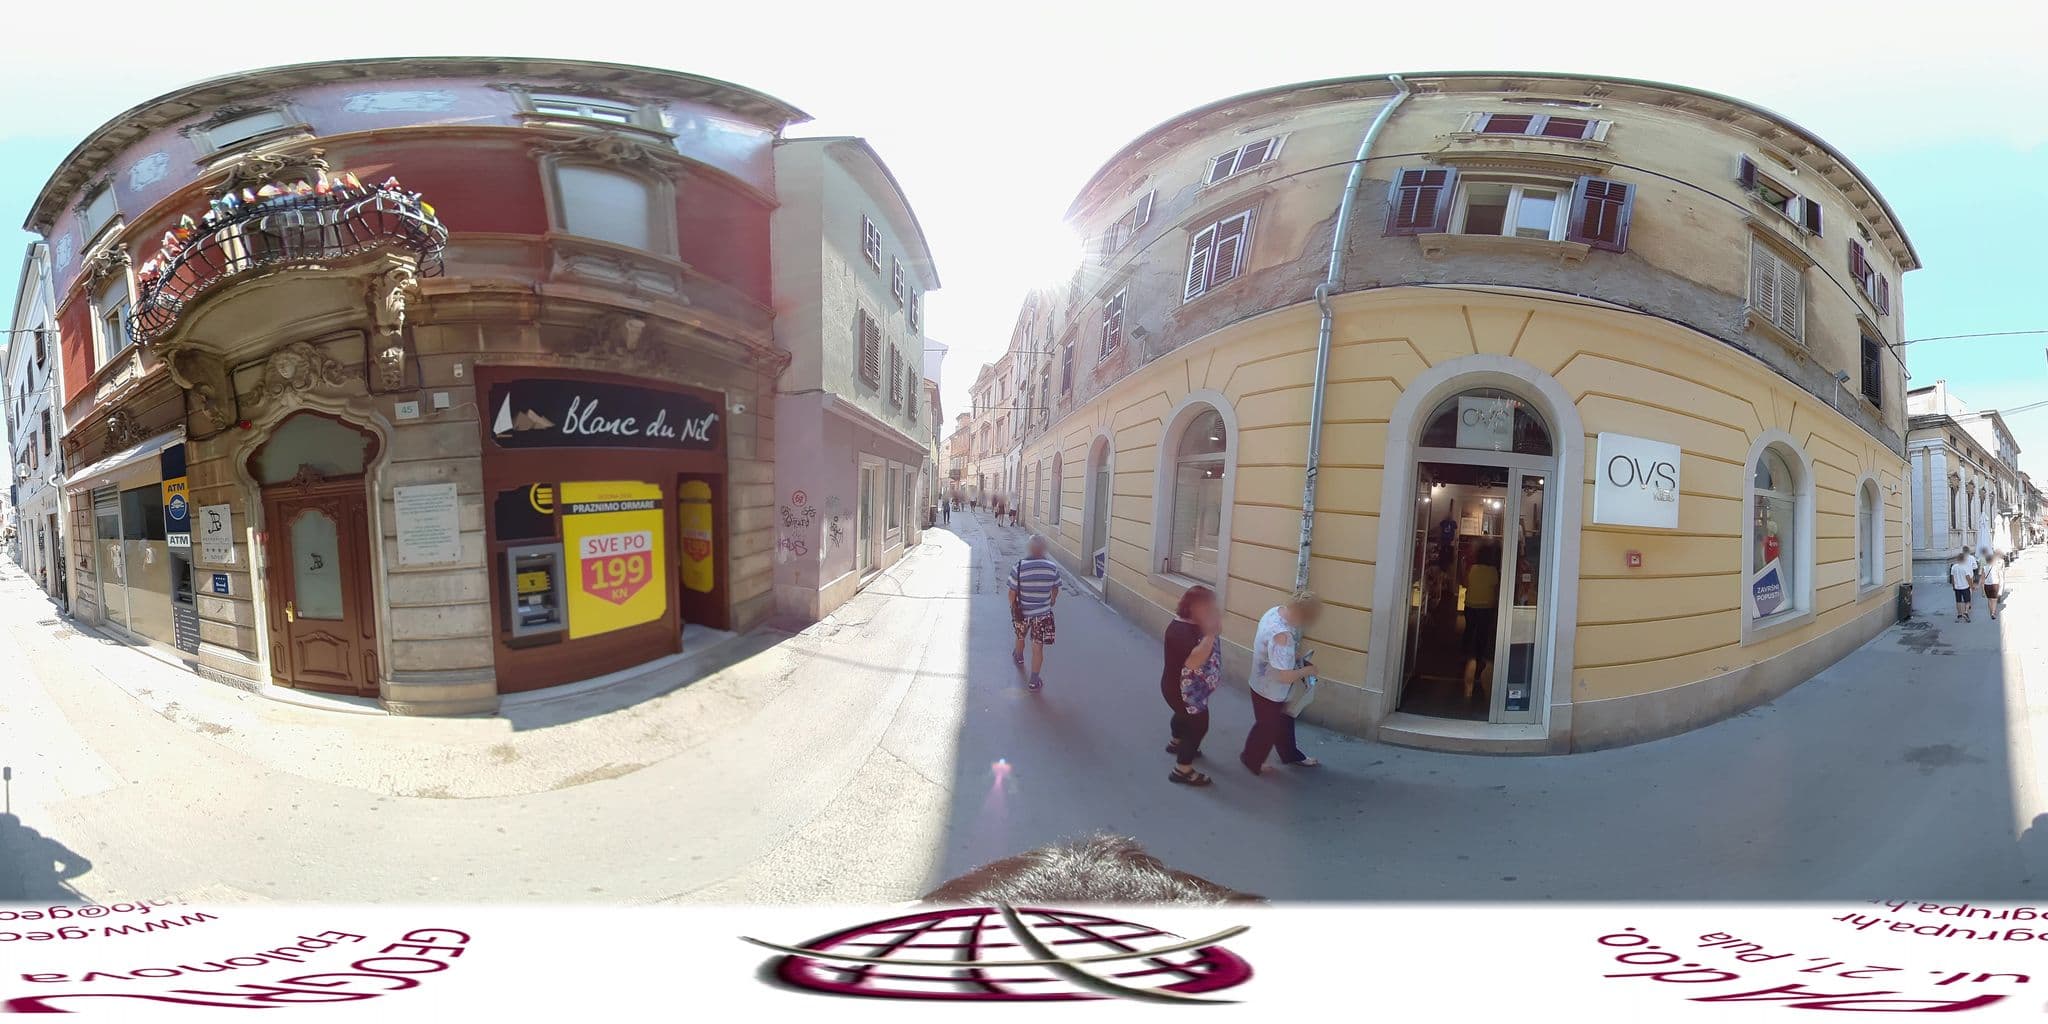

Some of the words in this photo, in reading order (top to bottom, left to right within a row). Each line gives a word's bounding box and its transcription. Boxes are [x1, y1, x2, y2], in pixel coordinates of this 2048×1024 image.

[401, 405, 413, 414] 45
[562, 395, 639, 435] Blanc
[646, 409, 675, 438] du
[681, 413, 715, 441] Nil
[1608, 455, 1676, 490] OVS
[168, 482, 185, 492] ATM
[572, 502, 619, 513] PRAZNIMO
[620, 500, 655, 510] ORMARE
[169, 536, 189, 546] ATM
[588, 537, 618, 554] SVE
[624, 534, 645, 550] PO
[591, 555, 645, 590] 199
[612, 588, 628, 599] KN
